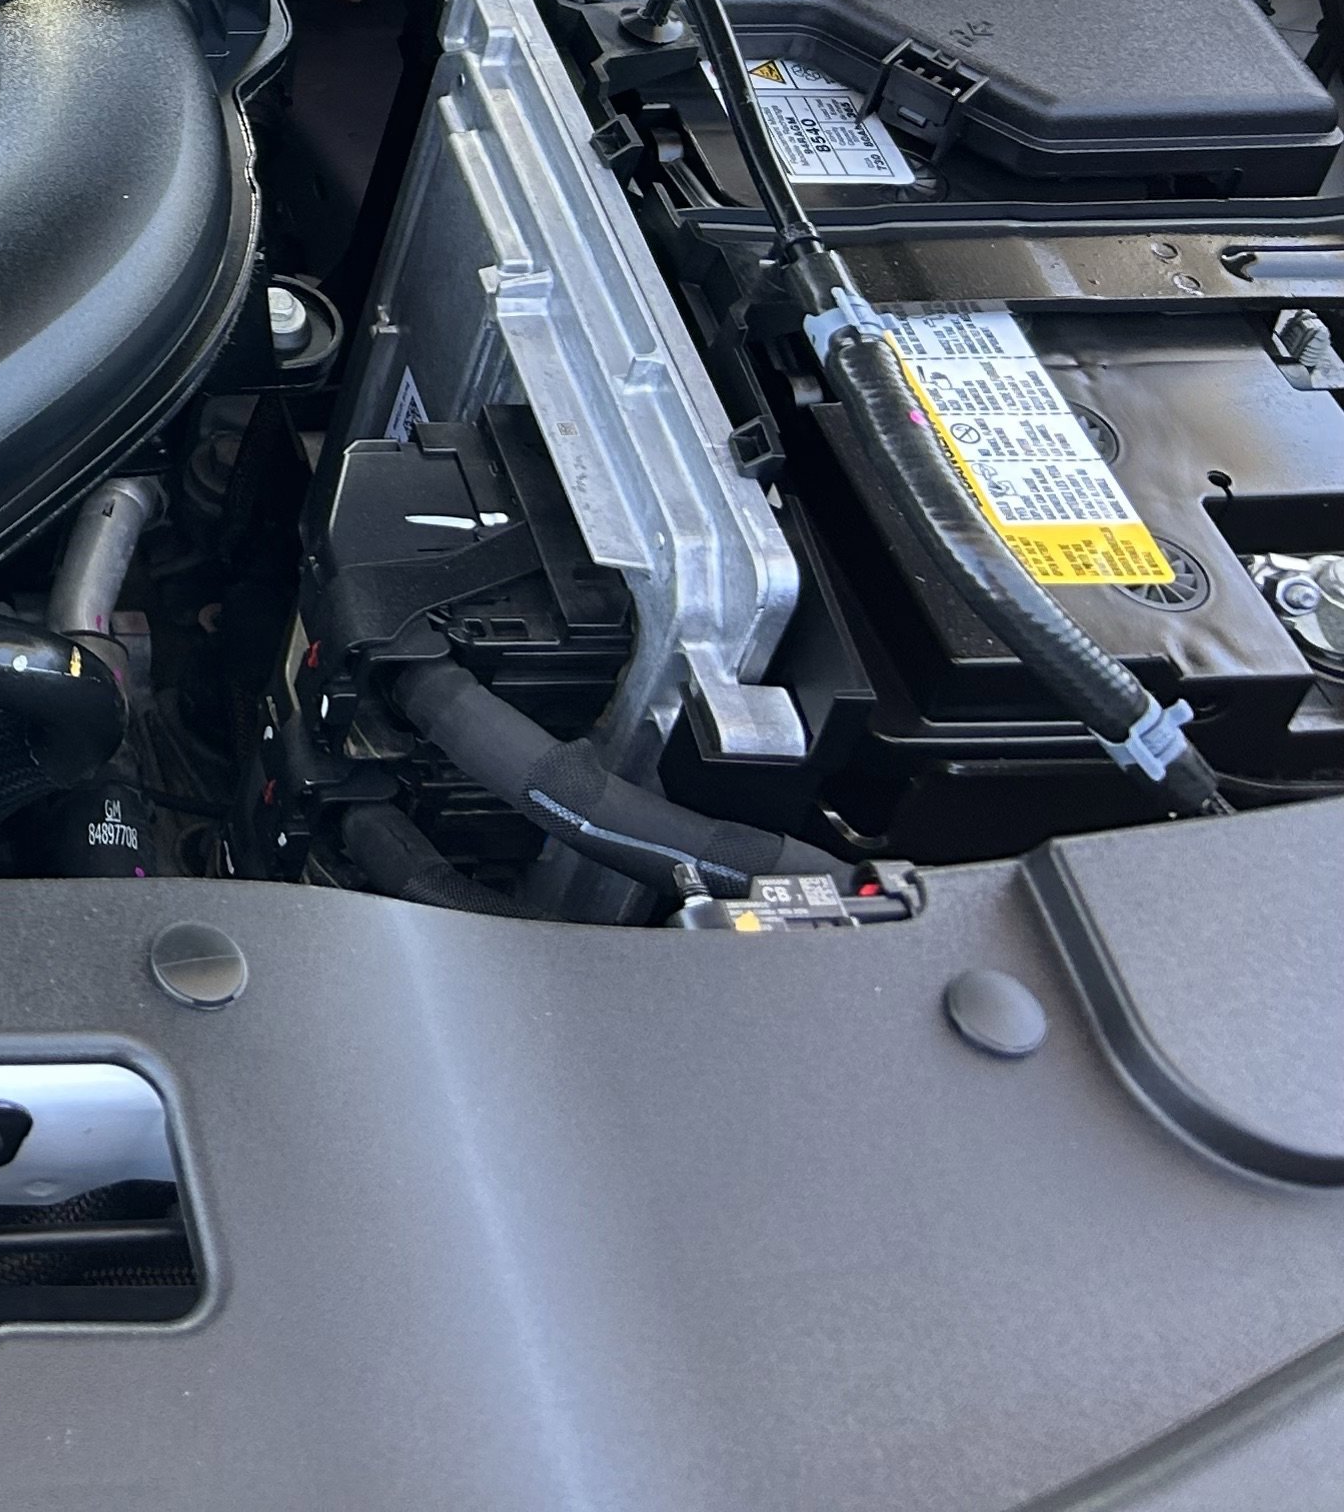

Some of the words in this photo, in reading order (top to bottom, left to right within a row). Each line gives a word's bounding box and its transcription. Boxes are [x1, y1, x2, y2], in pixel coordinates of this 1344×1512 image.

[786, 116, 813, 154] 94RAGM
[801, 118, 830, 152] 8540
[871, 153, 887, 170] 730
[104, 799, 121, 819] GM
[88, 822, 138, 850] 84897708
[761, 886, 792, 903] CB
